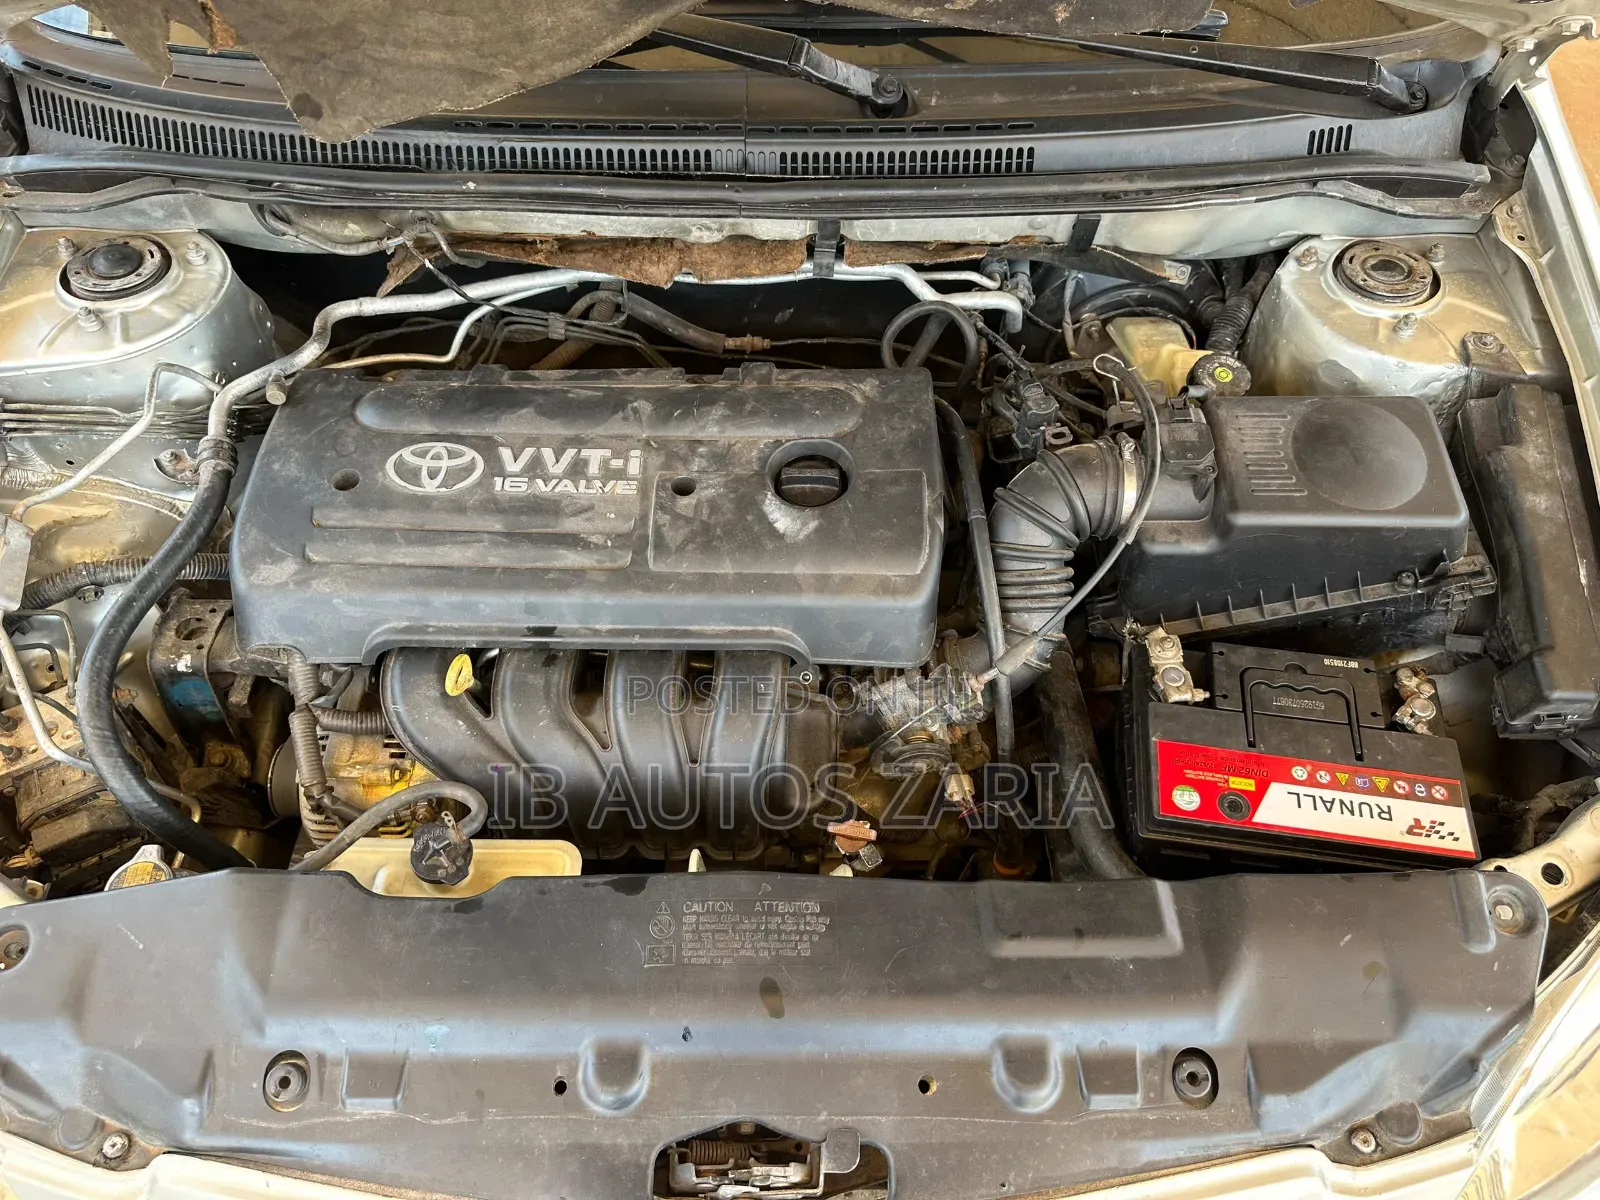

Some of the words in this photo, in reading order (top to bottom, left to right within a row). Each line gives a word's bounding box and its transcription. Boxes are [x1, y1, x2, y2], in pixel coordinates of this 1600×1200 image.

[498, 446, 643, 478] VVT-i
[493, 476, 530, 493] 16
[535, 478, 638, 495] VALVE
[1220, 764, 1237, 774] MF
[1238, 766, 1269, 778] DIN62
[1287, 791, 1393, 822] RUNALL
[683, 901, 734, 913] CAUTION
[754, 901, 820, 914] ATTENTION
